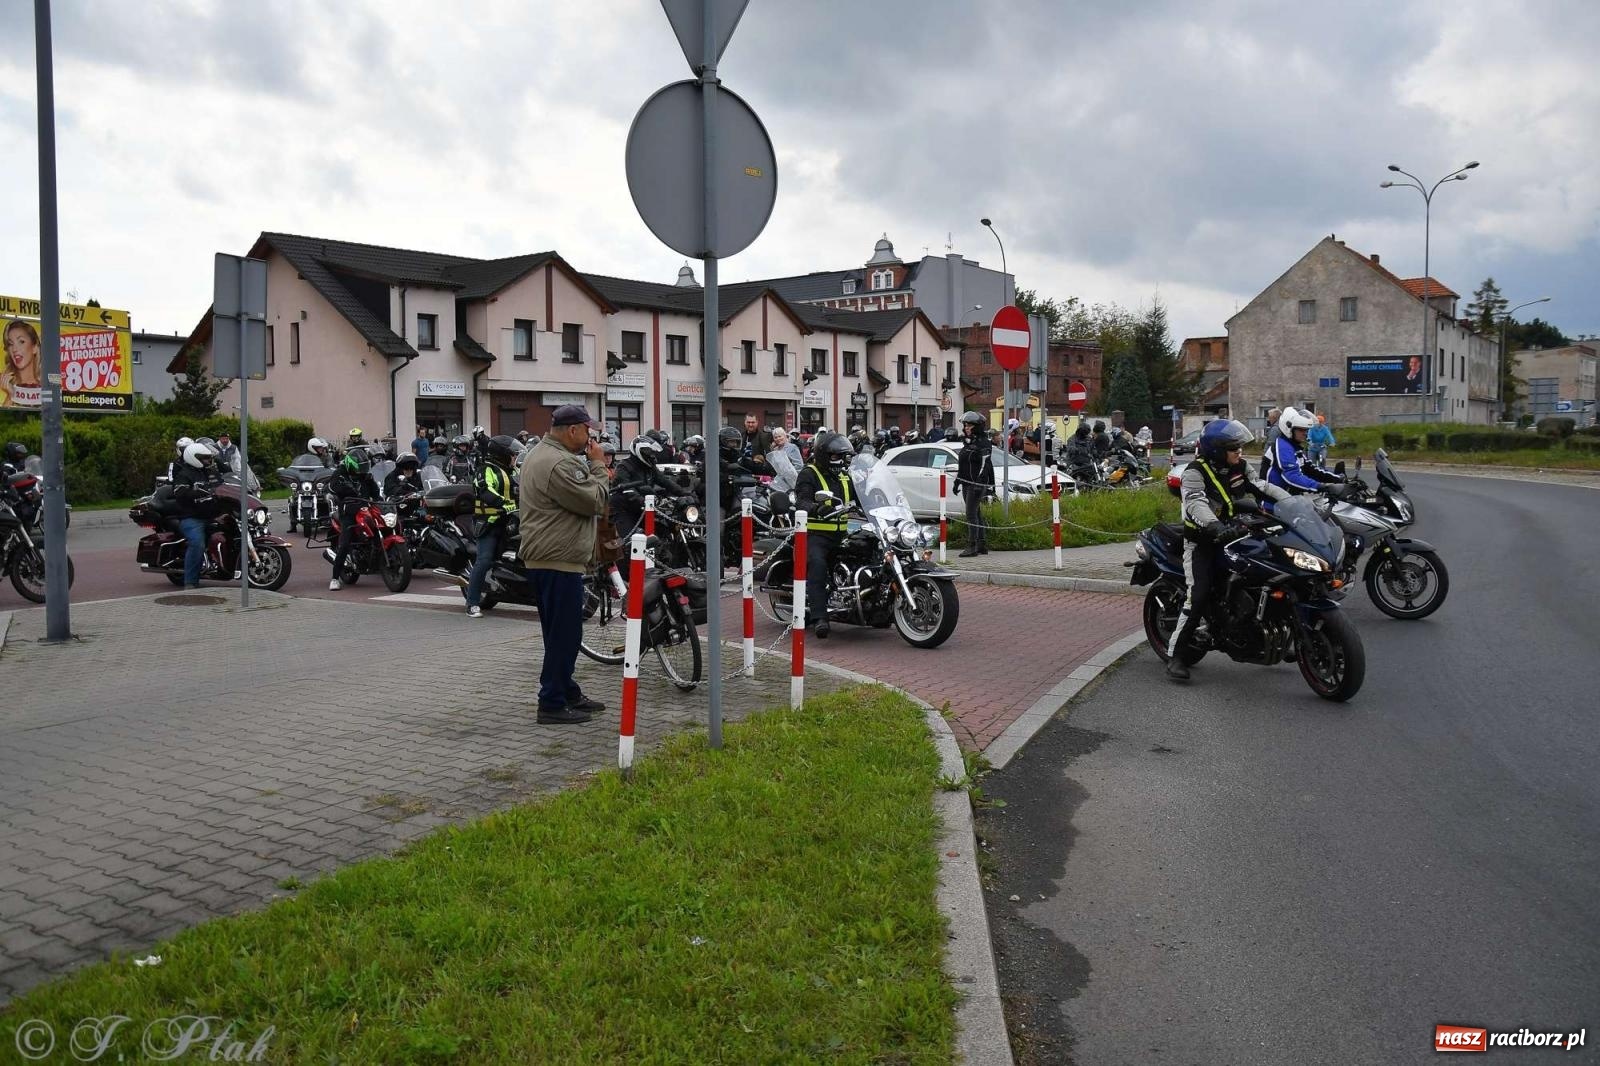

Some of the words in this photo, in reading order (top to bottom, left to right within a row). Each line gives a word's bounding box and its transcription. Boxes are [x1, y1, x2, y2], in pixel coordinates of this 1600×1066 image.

[0, 297, 16, 313] UL.
[73, 308, 85, 320] 97
[71, 347, 115, 361] URODZINY!
[63, 394, 117, 406] mediaexpert
